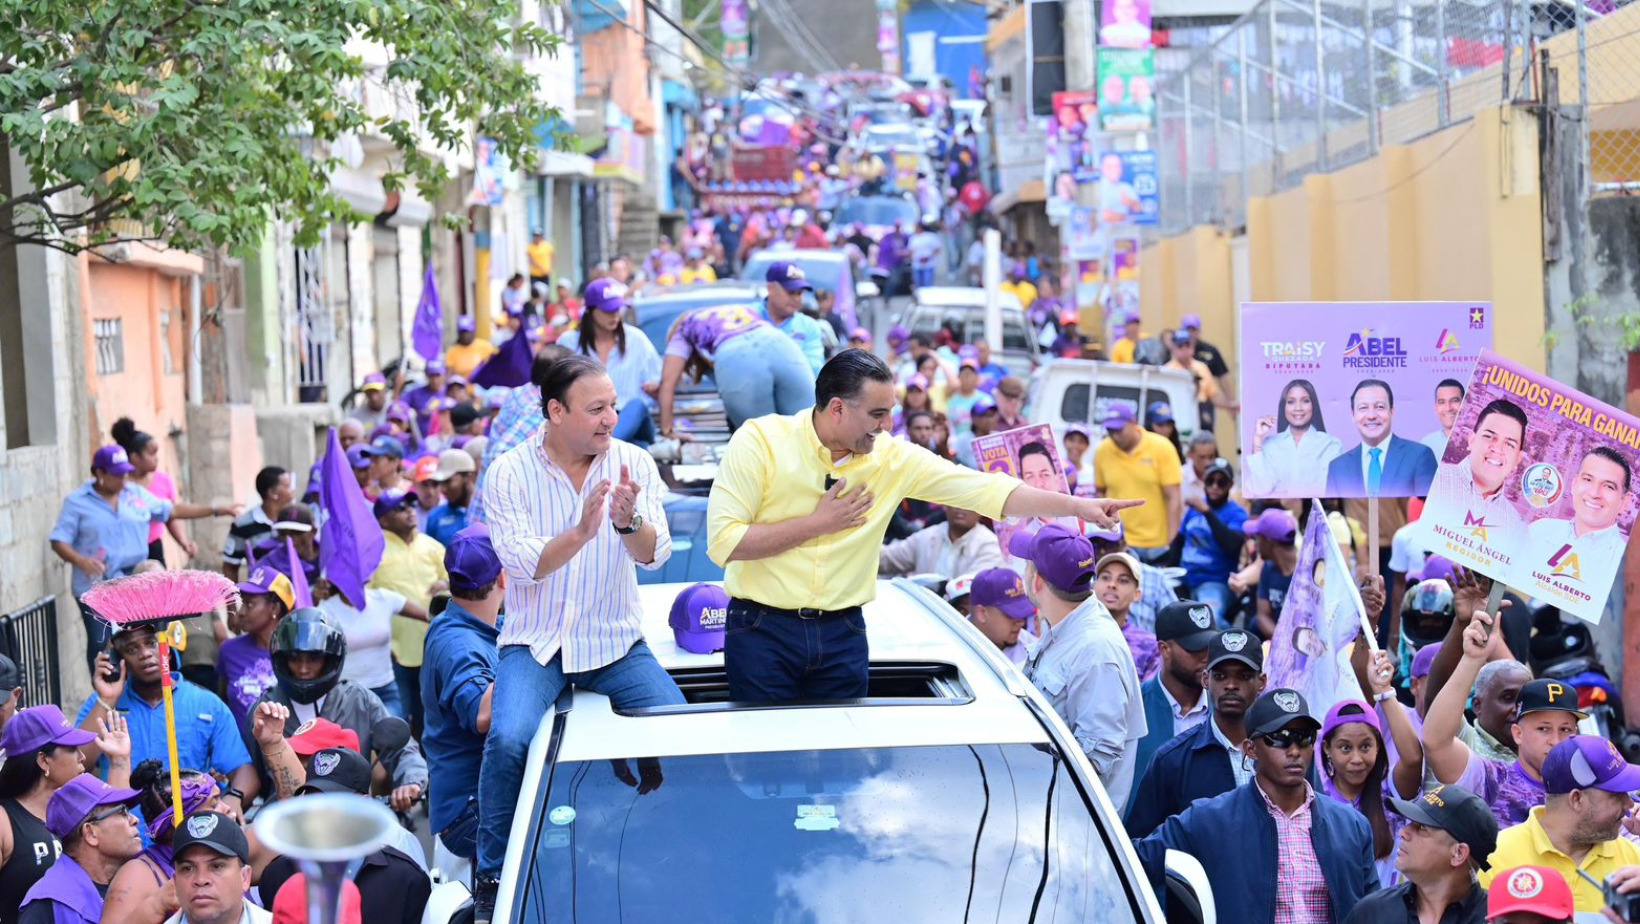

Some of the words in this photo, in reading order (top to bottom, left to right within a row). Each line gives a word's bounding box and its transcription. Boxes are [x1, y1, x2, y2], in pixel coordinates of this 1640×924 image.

[1343, 331, 1407, 356] ABEL
[1342, 356, 1407, 368] PRESIDENTE
[1482, 365, 1551, 407] ¡UNIDOS
[1550, 393, 1593, 428] PARA
[982, 446, 1008, 461] VOTA
[1433, 524, 1475, 549] MIGUEL
[1446, 541, 1492, 567] REGIDOR
[1532, 570, 1551, 583] LUIS
[1552, 581, 1591, 601] ALBERTO
[701, 606, 727, 620] ABE
[1547, 683, 1564, 703] P
